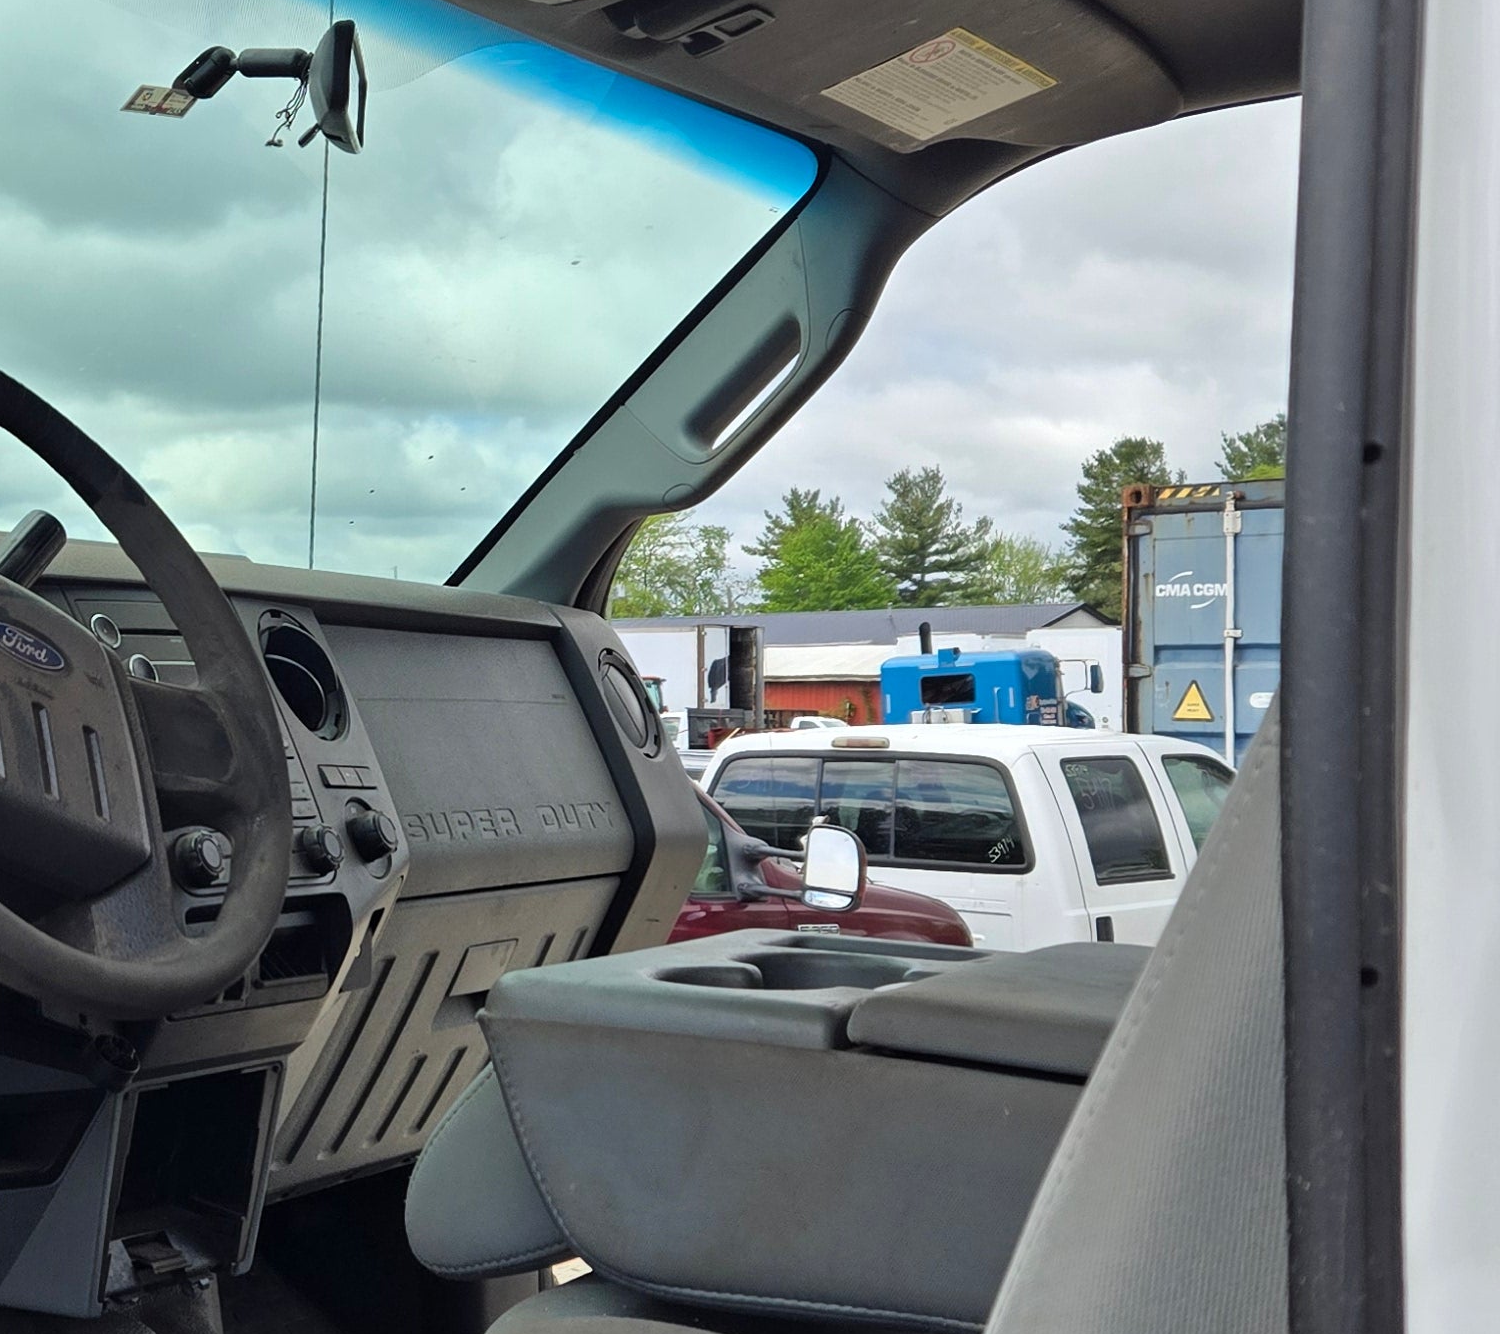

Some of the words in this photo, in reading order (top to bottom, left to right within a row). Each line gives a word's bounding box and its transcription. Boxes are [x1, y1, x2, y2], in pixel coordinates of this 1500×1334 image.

[1155, 583, 1191, 597] CMA
[1193, 583, 1227, 597] CGM
[2, 627, 48, 663] Ford
[402, 807, 522, 843] SUPER
[535, 801, 615, 832] DUTY
